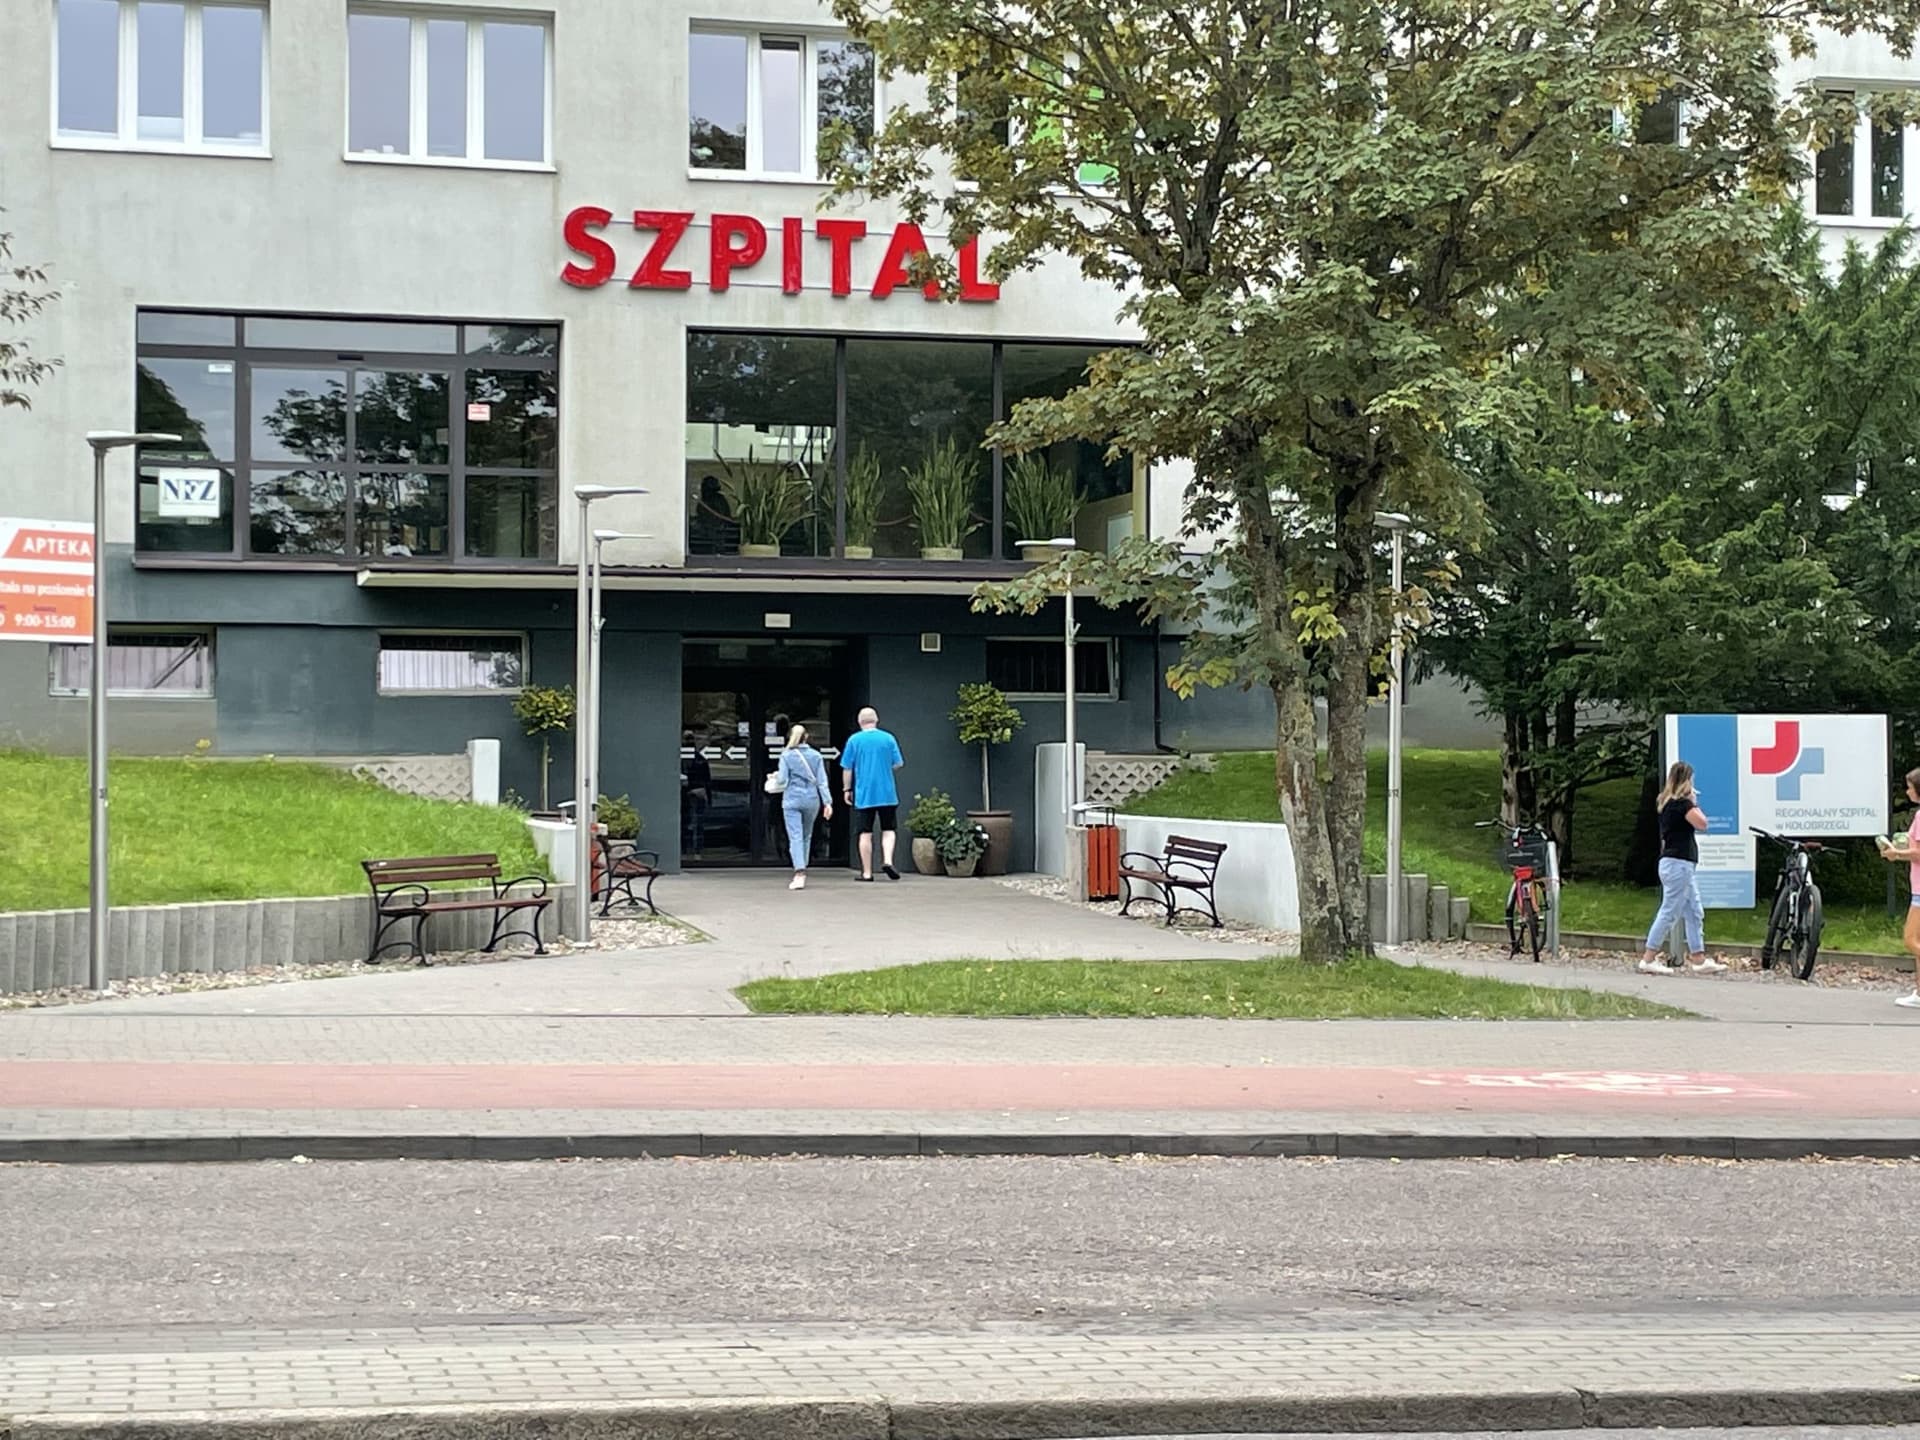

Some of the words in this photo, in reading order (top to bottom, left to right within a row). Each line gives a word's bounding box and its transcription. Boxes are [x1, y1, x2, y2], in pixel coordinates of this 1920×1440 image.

[560, 206, 1000, 302] SZPITAL
[162, 479, 216, 501] NFZ
[23, 537, 92, 556] APTEKA
[1775, 807, 1837, 818] REGIONALNY
[1839, 807, 1877, 818] SZPITAL
